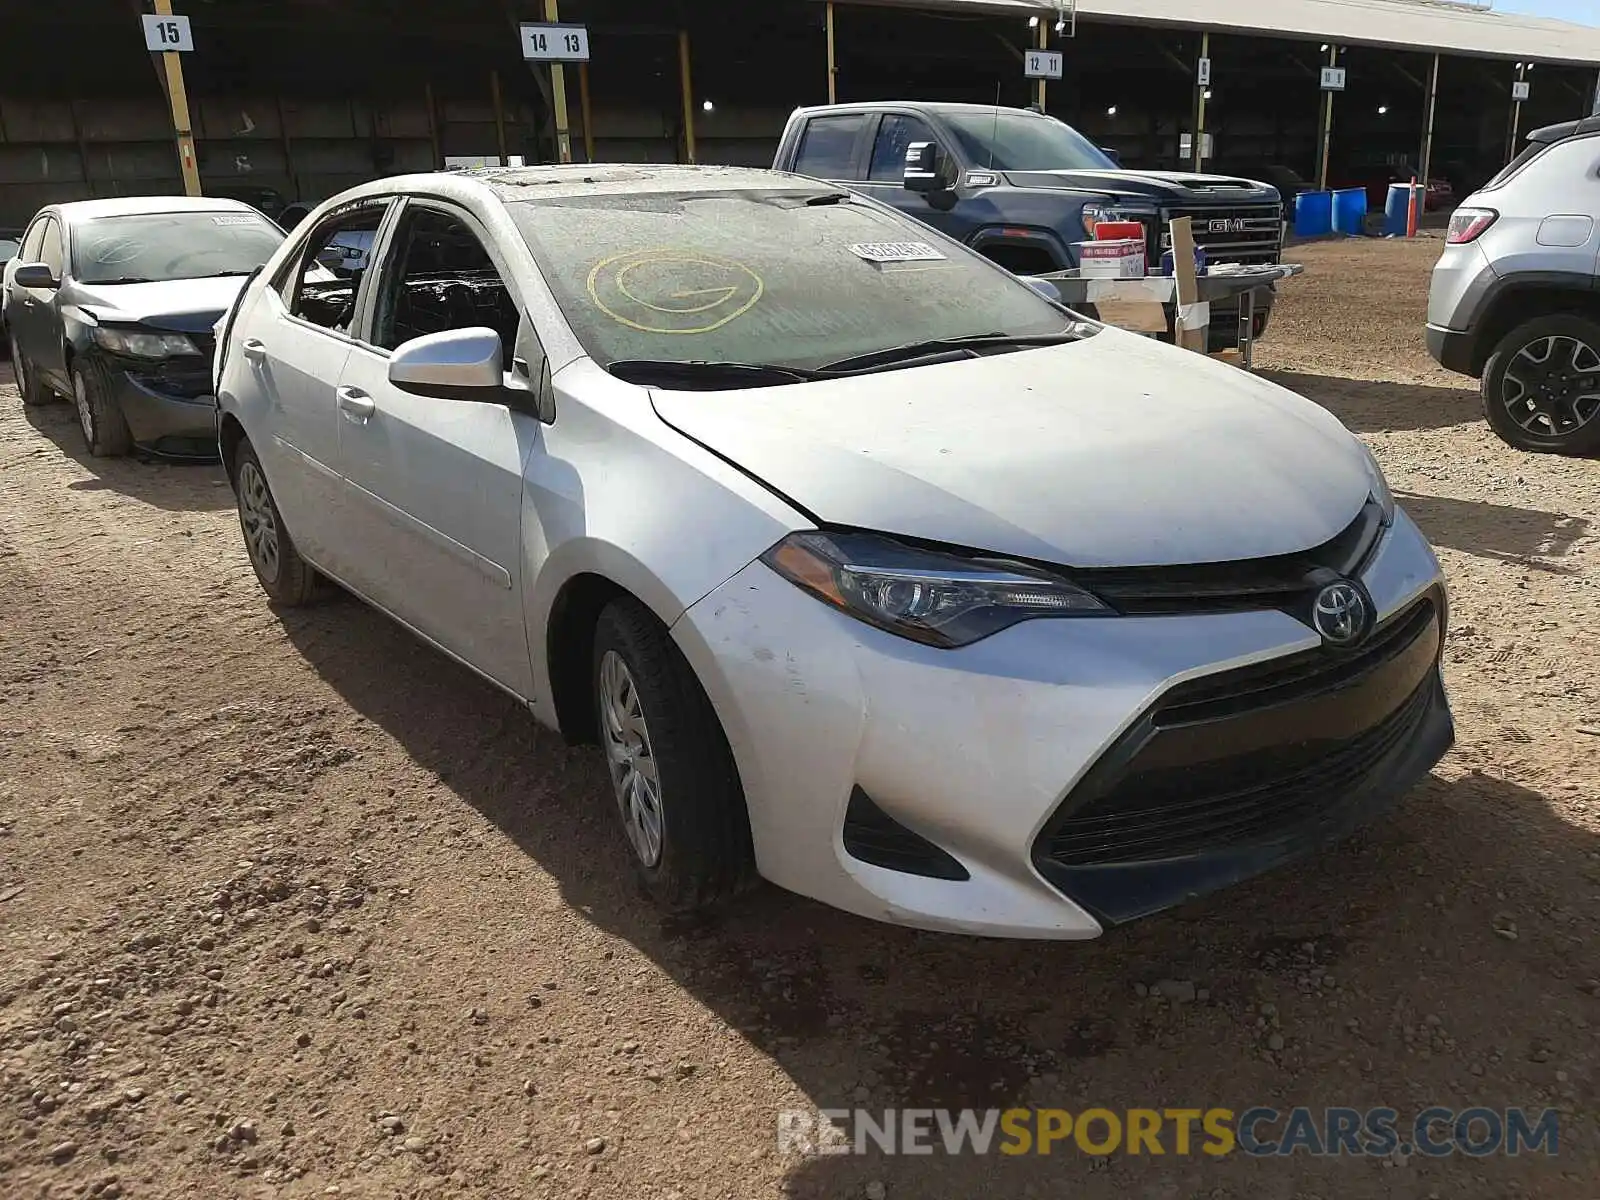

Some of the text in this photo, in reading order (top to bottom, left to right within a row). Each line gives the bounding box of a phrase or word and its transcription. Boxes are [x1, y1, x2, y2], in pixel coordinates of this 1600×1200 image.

[156, 22, 180, 43] 15
[530, 33, 580, 53] 14 13
[1030, 56, 1057, 72] 12 11
[1209, 218, 1256, 233] GMC
